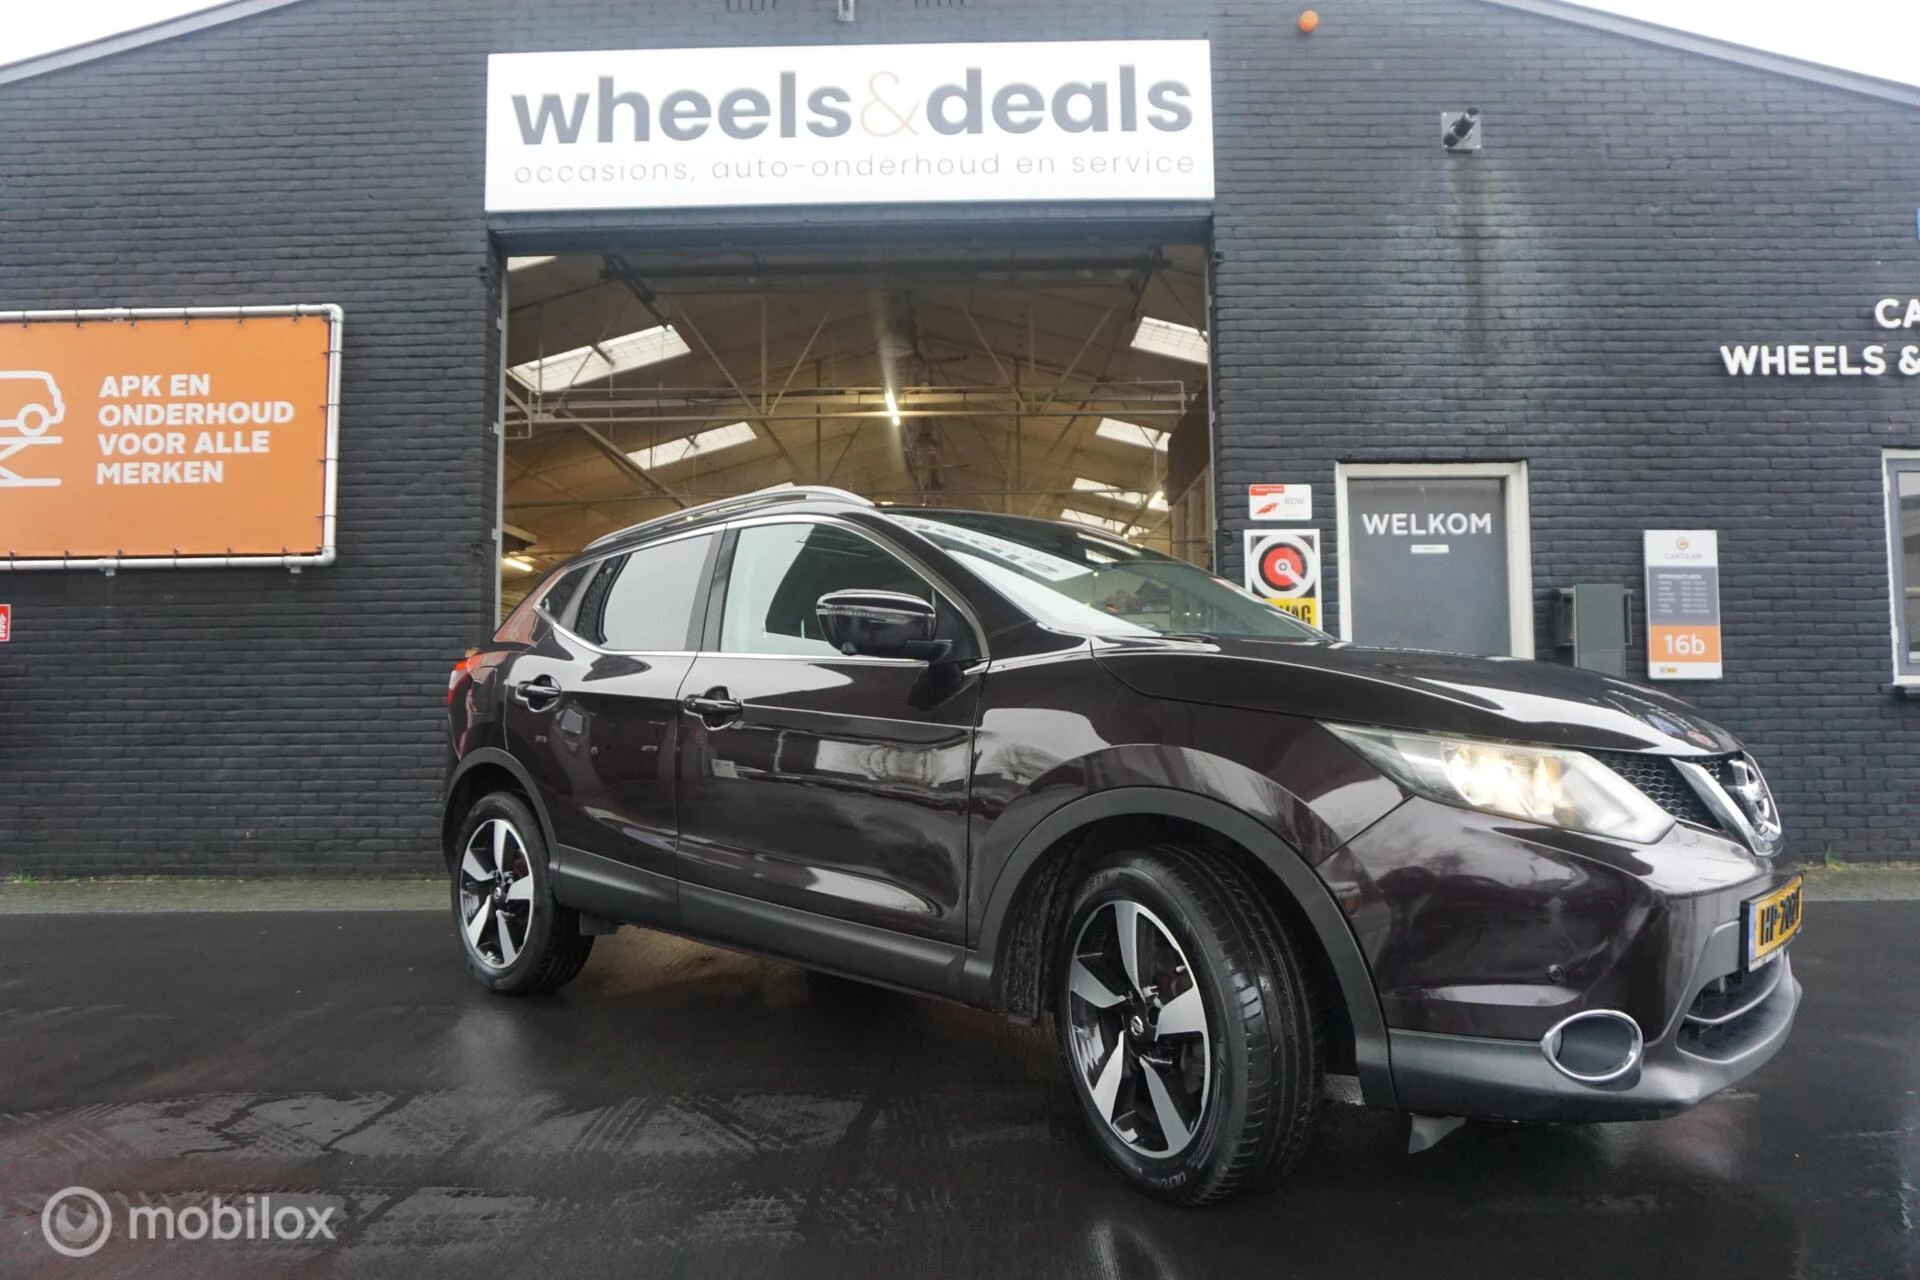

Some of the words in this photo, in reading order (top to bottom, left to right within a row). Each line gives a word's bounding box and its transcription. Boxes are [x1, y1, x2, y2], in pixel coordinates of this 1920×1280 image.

[510, 63, 1193, 145] wheels&deals
[514, 159, 696, 183] occasions,
[711, 153, 1000, 179] auto-onderhoud
[1016, 155, 1055, 174] en
[1071, 151, 1195, 174] service
[1720, 345, 1887, 376] WHEELS
[1898, 345, 1920, 376] &
[98, 375, 162, 398] APK
[170, 373, 210, 396] EN
[98, 401, 295, 427] ONDERHOUD
[97, 433, 186, 456] VOOR
[194, 431, 270, 454] ALLE
[96, 460, 224, 485] MERKEN
[1361, 512, 1493, 536] WELKOM
[1664, 633, 1706, 656] 16b
